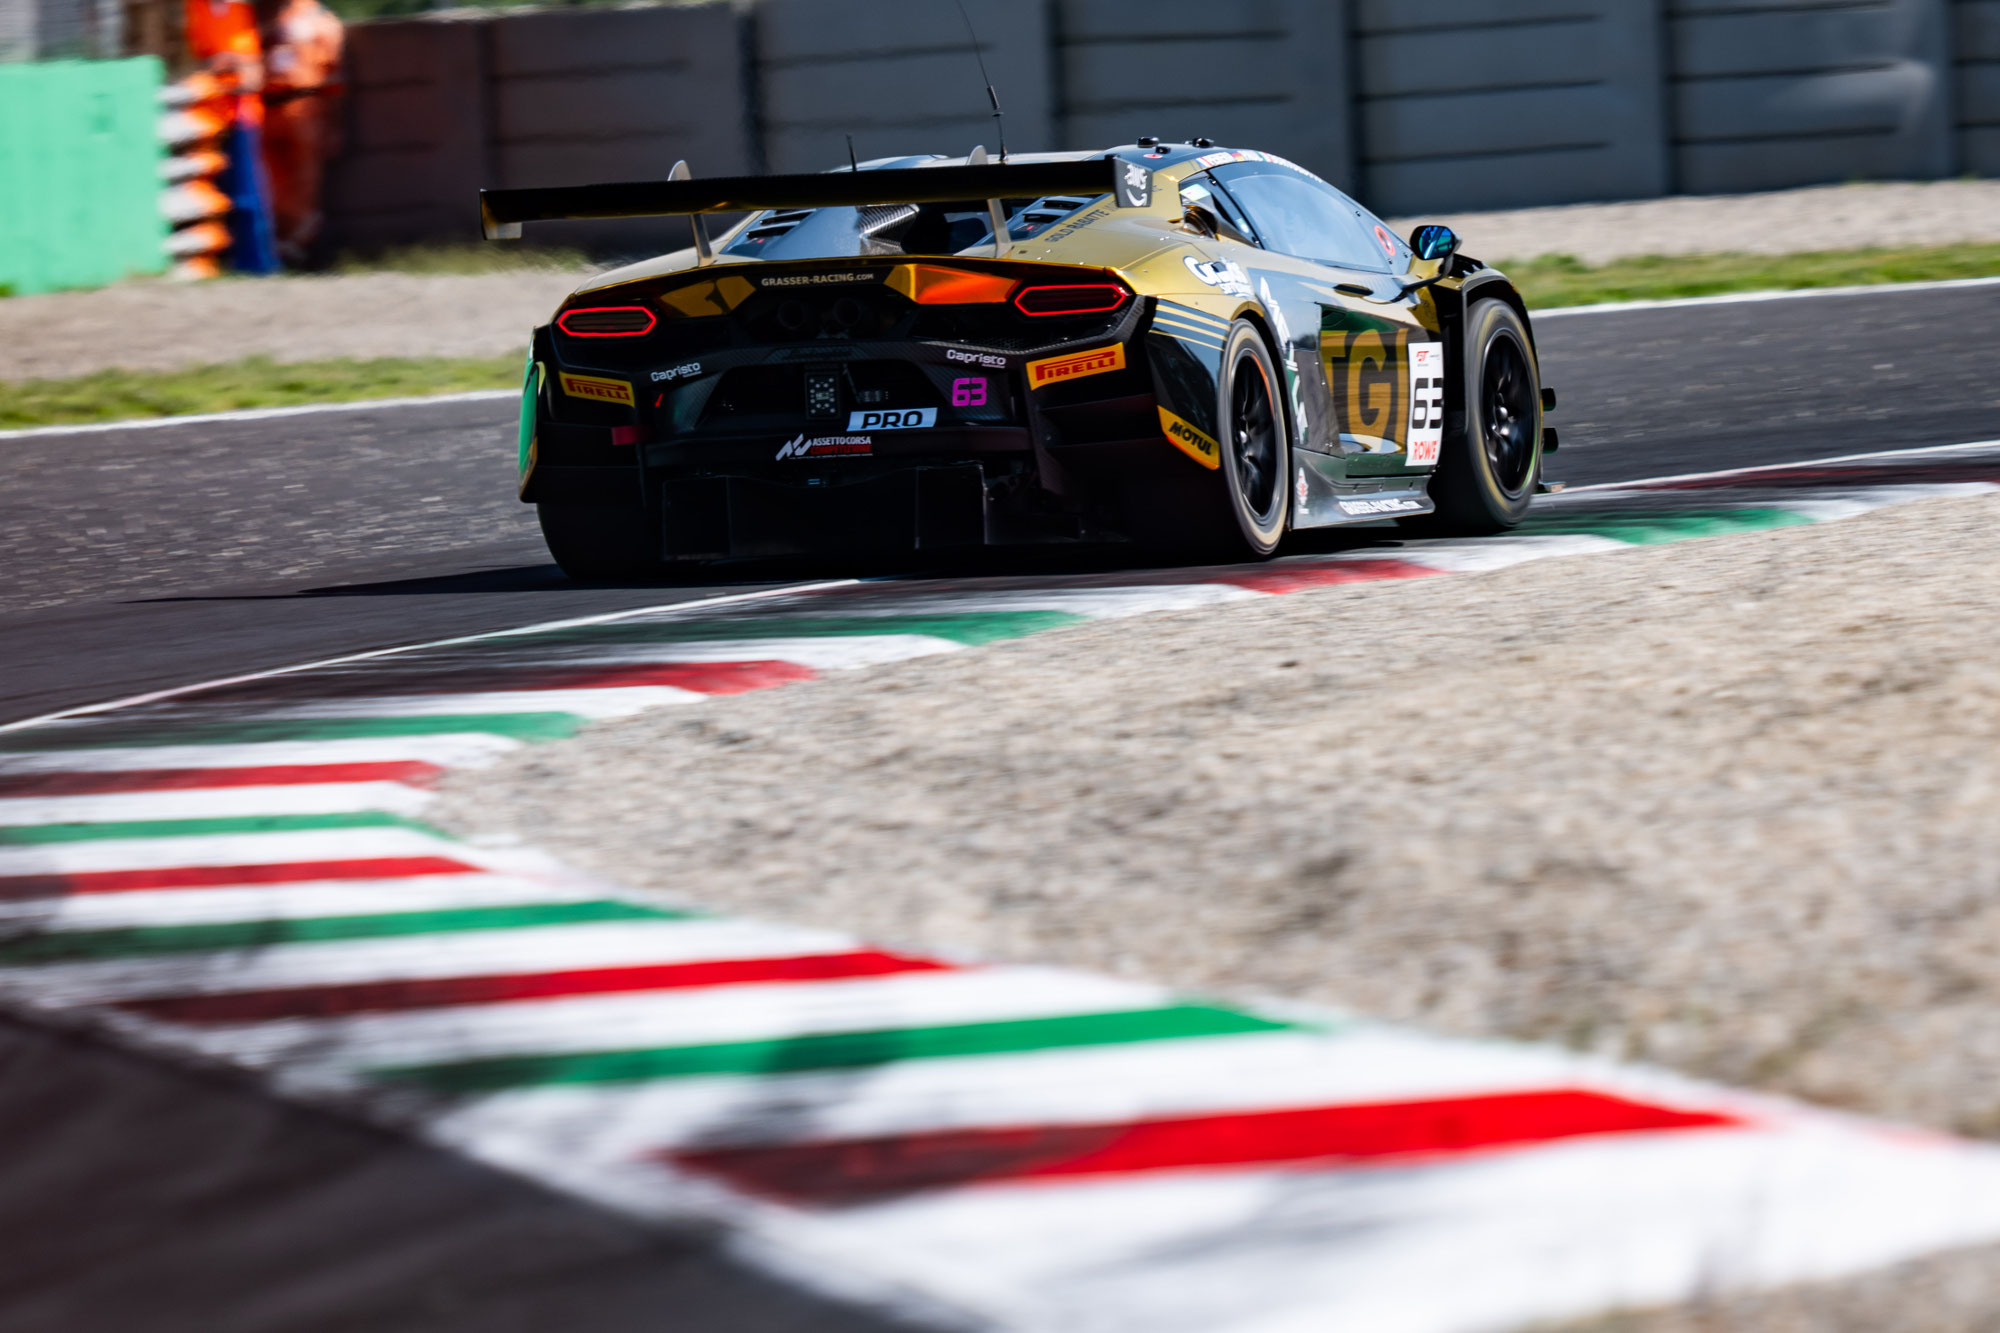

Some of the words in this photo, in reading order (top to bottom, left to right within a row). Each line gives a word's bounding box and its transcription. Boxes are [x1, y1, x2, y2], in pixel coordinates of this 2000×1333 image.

[1044, 226, 1075, 242] GOLD
[946, 349, 1006, 366] Capristo
[1035, 351, 1115, 381] PIRELLI
[650, 362, 701, 382] Capristo
[564, 377, 631, 401] PIRELLI
[952, 377, 987, 406] 63
[1412, 378, 1443, 429] 63
[861, 411, 923, 429] PRO
[812, 437, 846, 446] ASSETTO
[846, 436, 872, 445] CORSA
[1169, 421, 1212, 456] MOTUL
